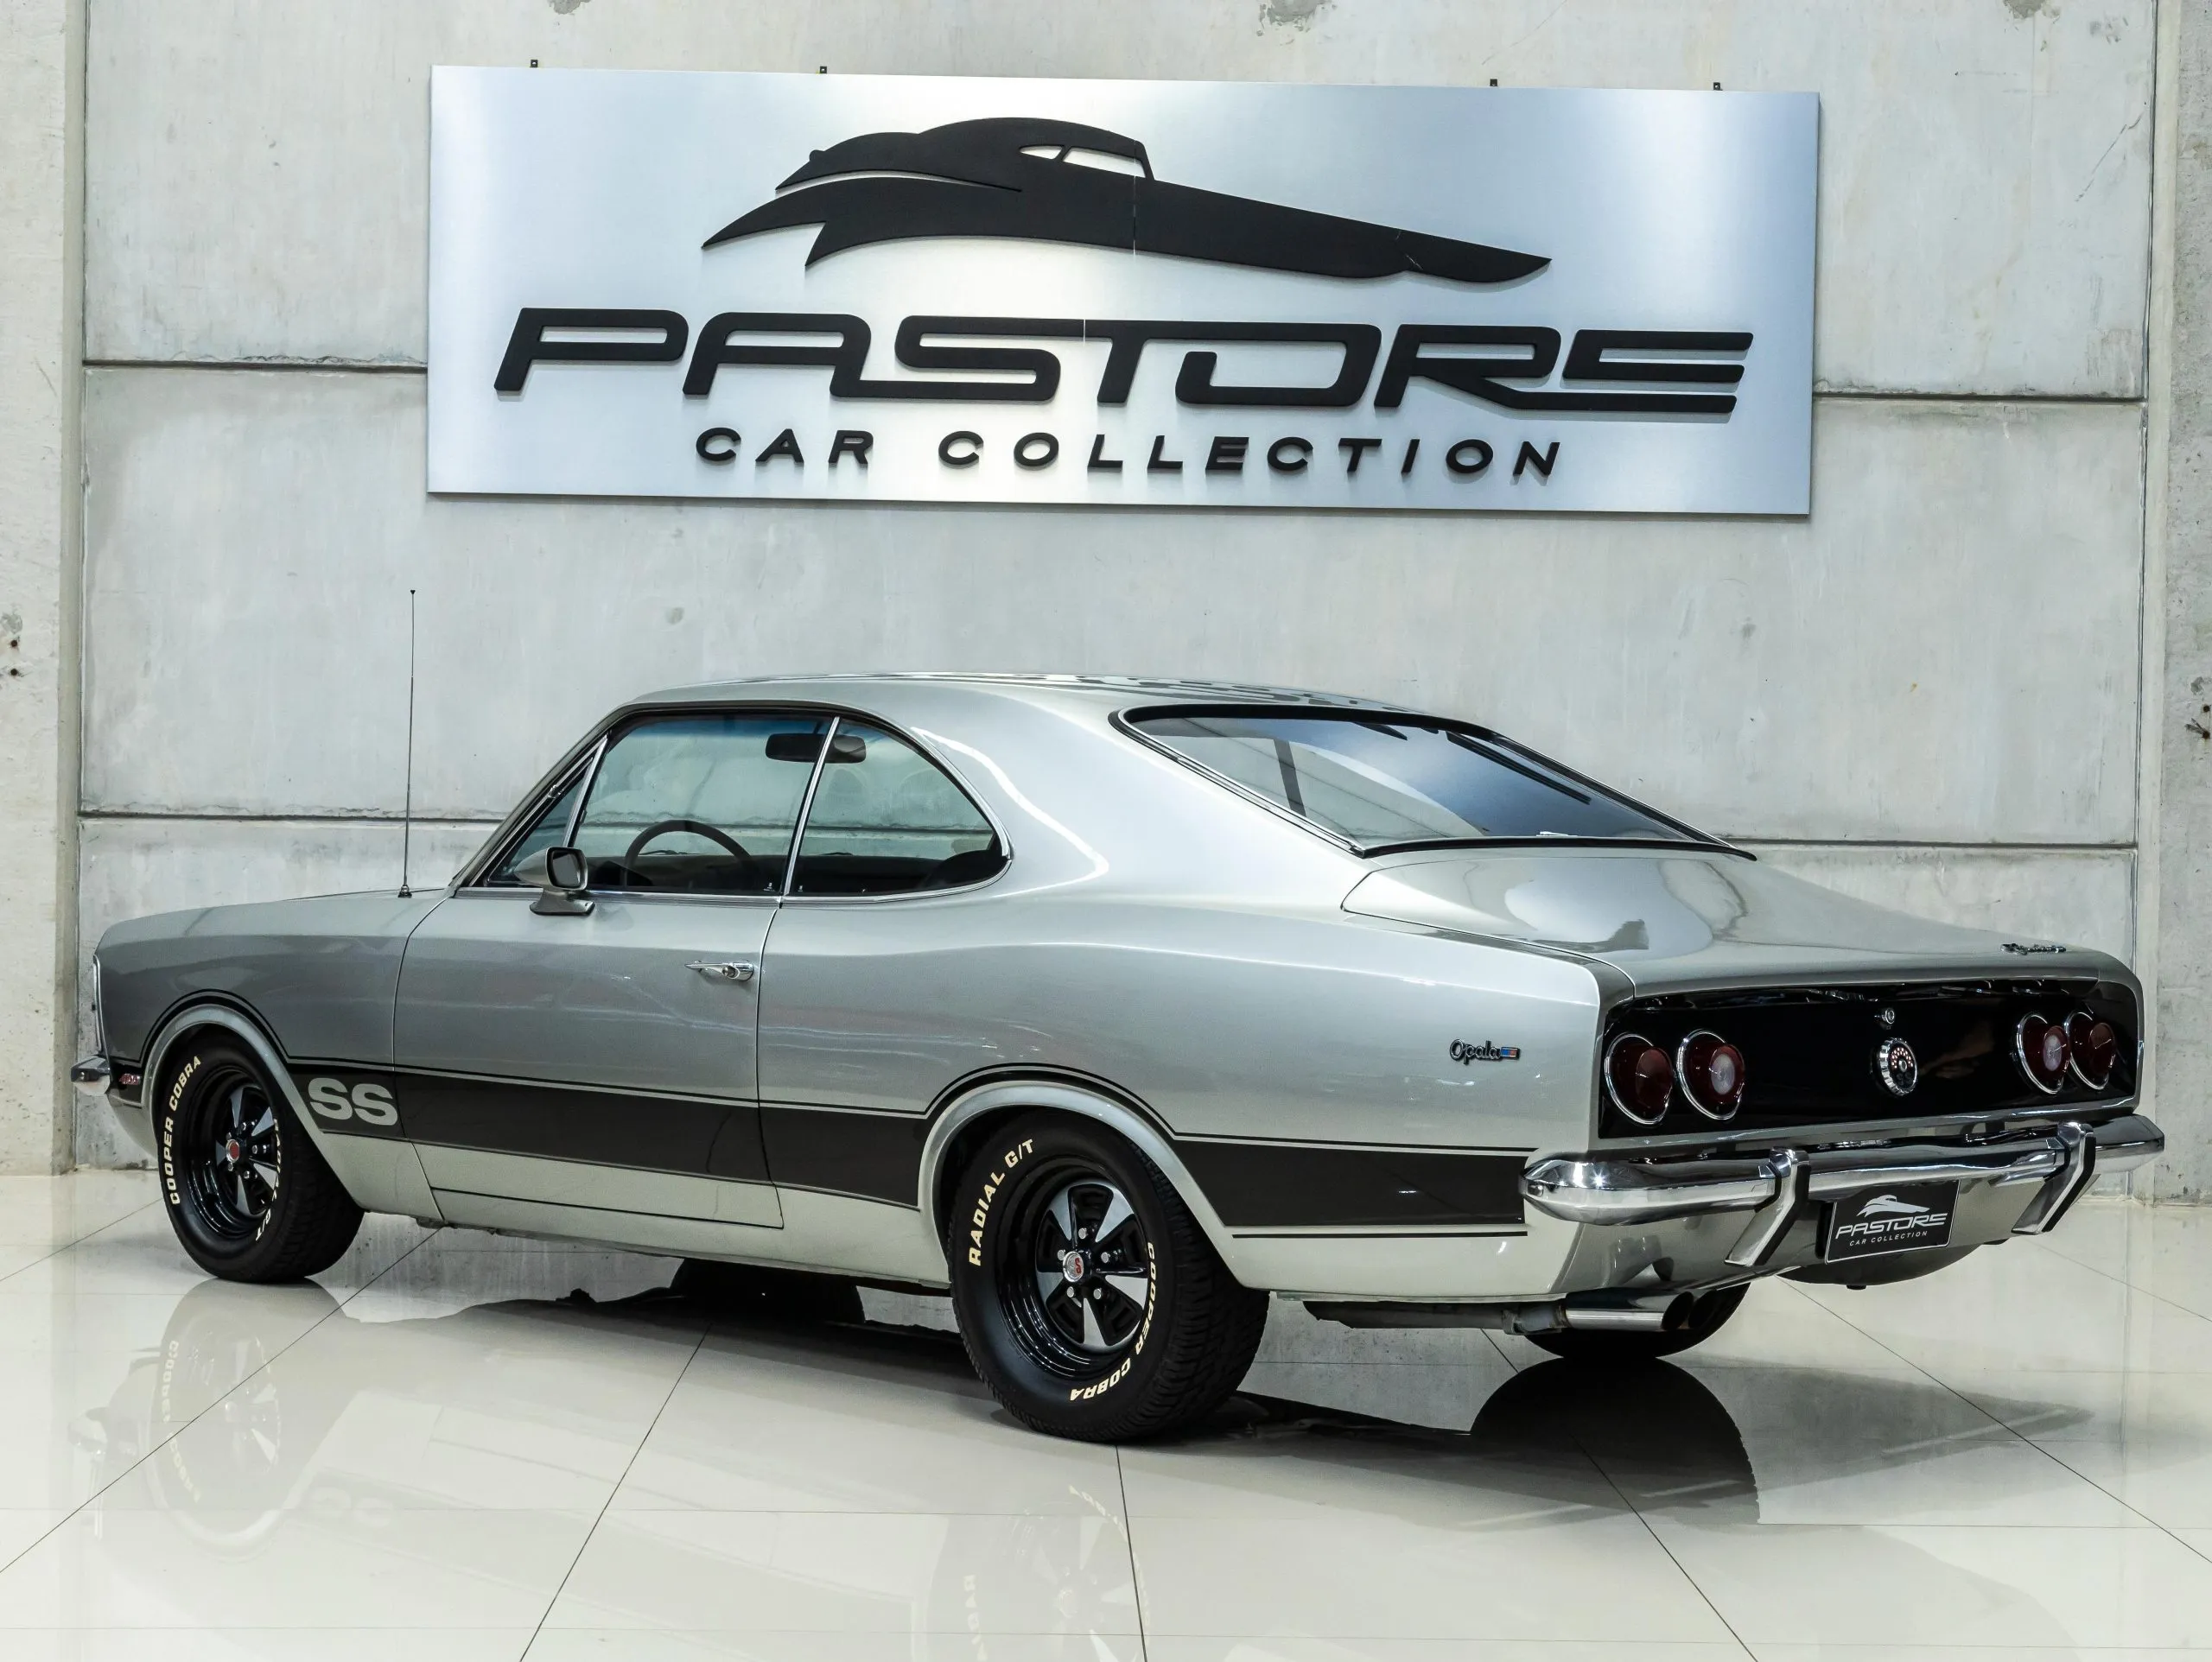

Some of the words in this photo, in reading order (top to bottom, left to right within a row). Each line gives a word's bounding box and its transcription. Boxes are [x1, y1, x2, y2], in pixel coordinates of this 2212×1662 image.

[494, 307, 1753, 413] PASTORE
[695, 427, 874, 466] CAR
[938, 430, 1560, 478] COLLECTION
[1450, 1038, 1501, 1065] Opala
[168, 1056, 201, 1112] COBRA
[308, 1077, 397, 1126] SS
[163, 1116, 181, 1205] COOPER
[969, 1171, 1006, 1266] RADIAL
[1004, 1139, 1033, 1169] G/T
[1834, 1213, 1948, 1240] PASTORE
[1849, 1238, 1866, 1246] CAR
[1871, 1230, 1928, 1243] COLLECTION
[1134, 1241, 1156, 1355] COOPER
[1070, 1358, 1131, 1401] COBRA
